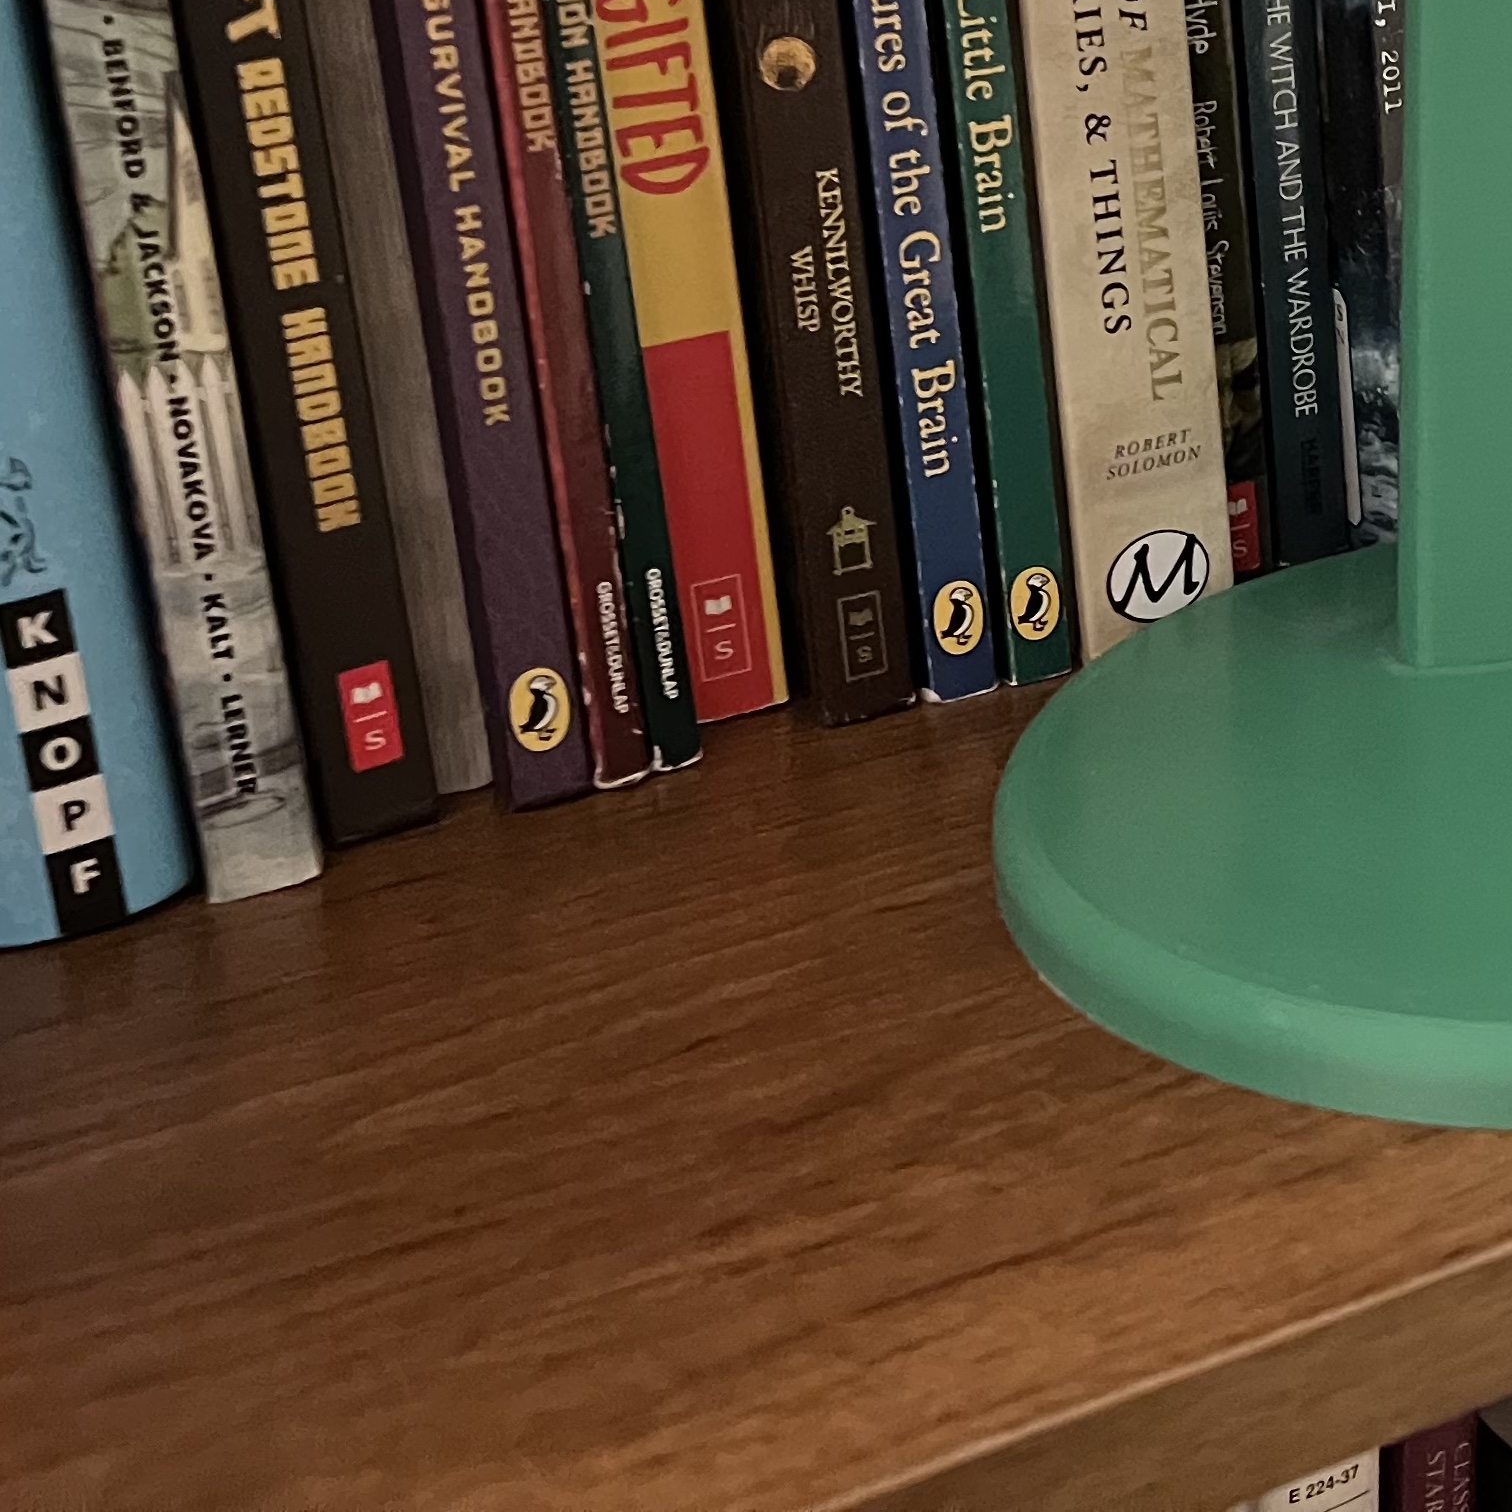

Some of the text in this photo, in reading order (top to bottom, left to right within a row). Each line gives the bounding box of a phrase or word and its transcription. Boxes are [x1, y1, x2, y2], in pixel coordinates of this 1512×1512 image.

[881, 90, 929, 136] of
[1083, 113, 1113, 146] &
[1269, 32, 1300, 130] WITCH
[1381, 50, 1403, 116] 2011
[565, 61, 619, 240] HANDBOOK
[887, 149, 932, 217] the
[968, 114, 1018, 233] Brain
[1276, 140, 1304, 201] AND
[815, 167, 865, 399] KENNILWORTHY
[1088, 159, 1133, 337] THINGS
[1118, 45, 1185, 402] MATHEMATICAL
[1282, 205, 1309, 263] THE
[236, 57, 321, 291] REDSTONE
[281, 306, 362, 533] HANDBOOK
[453, 203, 513, 427] HANDBOOK
[790, 246, 822, 333] WHISP
[898, 230, 943, 350] Great
[1286, 266, 1319, 418] WARDROBE
[910, 358, 959, 479] Brain
[1105, 445, 1203, 483] SOLOMON
[1114, 428, 1193, 460] ROBERT
[135, 220, 182, 368] JACKSON
[166, 395, 218, 561] NOVAKOVA
[200, 592, 237, 661] KALT
[222, 693, 260, 795] LERNER
[17, 610, 102, 894] KNOPF
[1288, 1465, 1360, 1504] E 224-37
